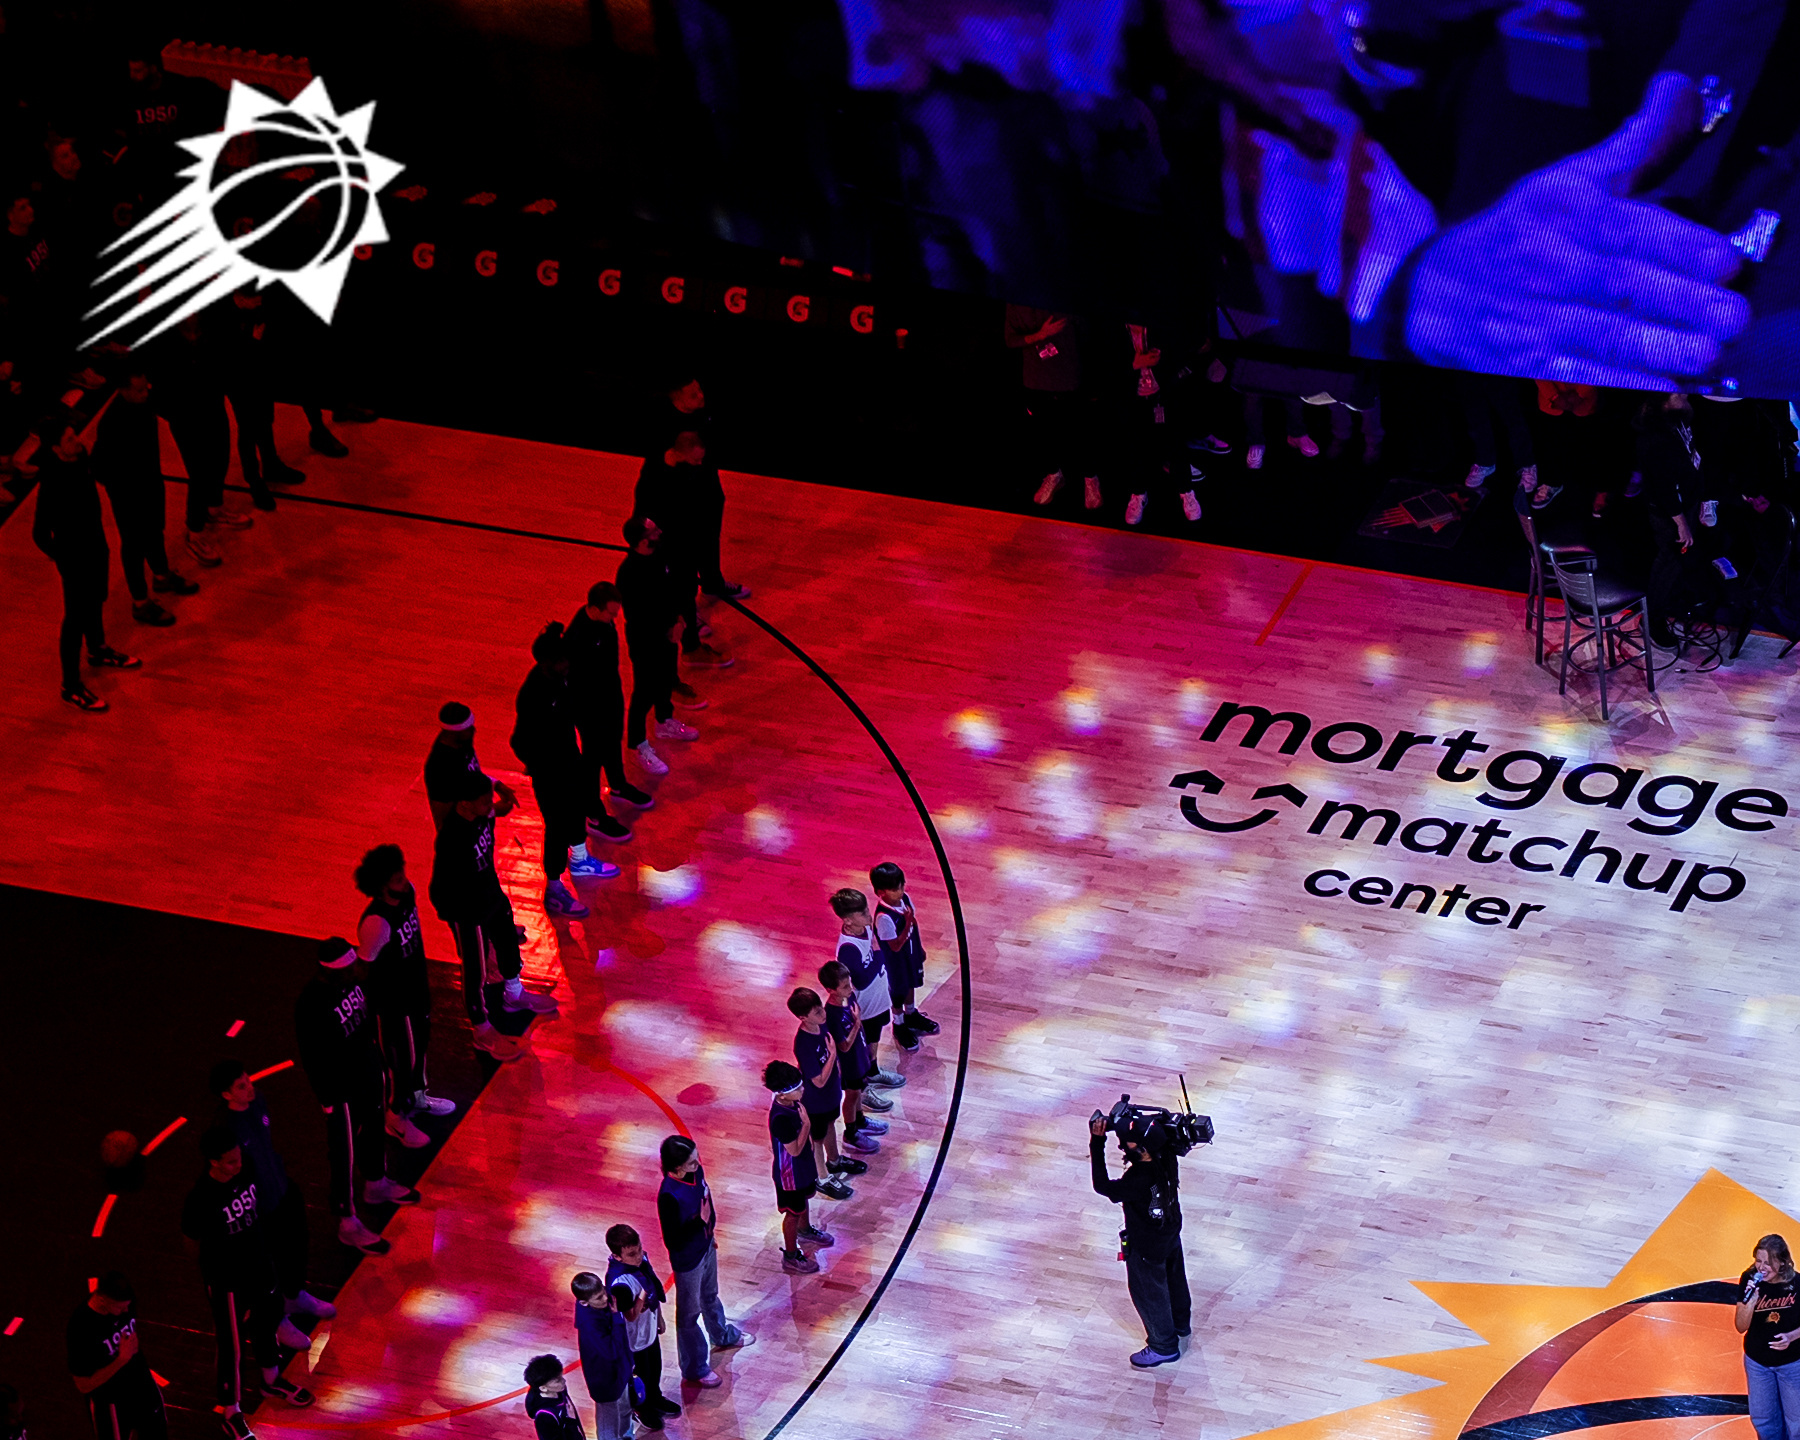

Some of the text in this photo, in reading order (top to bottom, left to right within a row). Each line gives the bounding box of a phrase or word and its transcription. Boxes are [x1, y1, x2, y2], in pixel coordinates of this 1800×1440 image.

[134, 104, 178, 124] 1950
[412, 242, 435, 269] G
[474, 250, 498, 277] G
[536, 259, 559, 286] G
[598, 268, 621, 295] G
[661, 276, 685, 304] G
[724, 286, 747, 314] G
[786, 294, 810, 323] G
[850, 304, 875, 334] G
[1199, 701, 1789, 836] mortgage
[1307, 800, 1747, 912] matchup
[1303, 869, 1546, 931] center
[396, 908, 419, 946] 195
[333, 984, 366, 1024] 1950
[1756, 1292, 1797, 1310] hoenix
